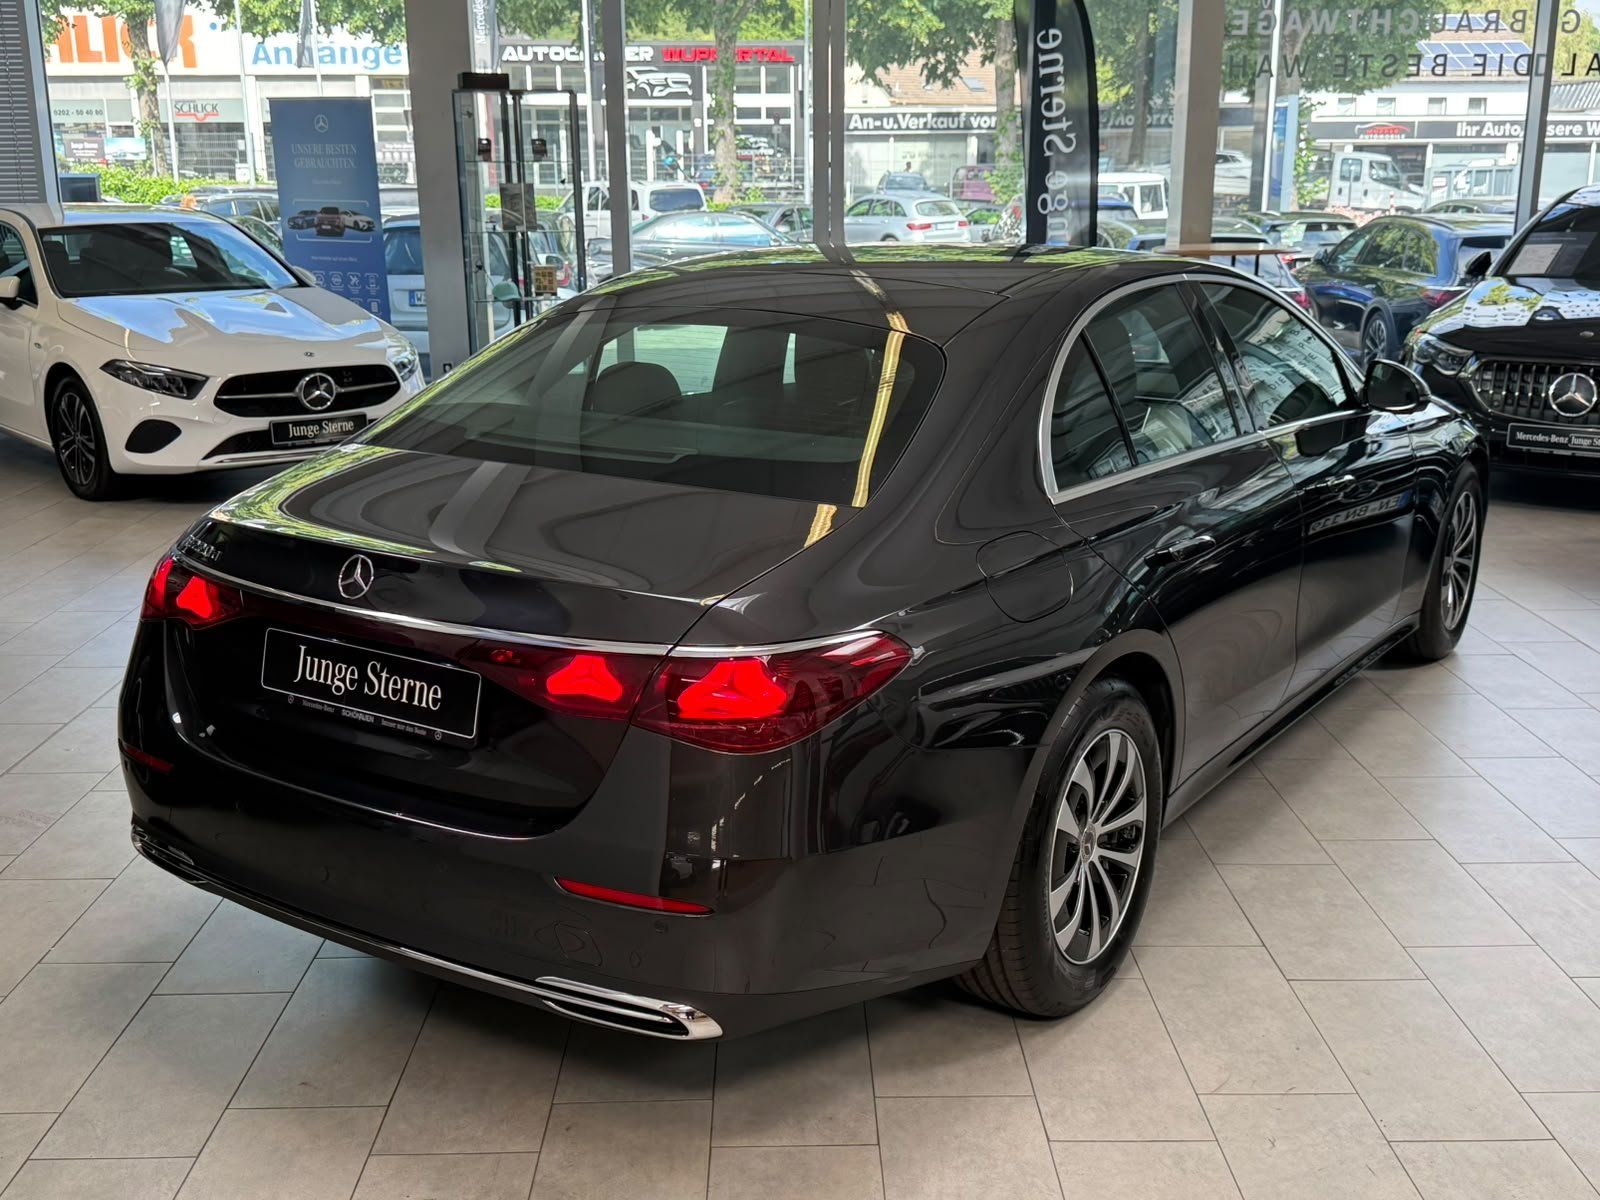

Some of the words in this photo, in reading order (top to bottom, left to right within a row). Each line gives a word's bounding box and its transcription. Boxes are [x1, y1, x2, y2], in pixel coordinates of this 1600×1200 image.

[501, 45, 654, 62] AUTOCER
[1456, 121, 1481, 137] Ihr
[288, 422, 320, 439] Junge
[322, 420, 355, 434] Sterne
[293, 644, 359, 696] Junge
[363, 660, 442, 711] Sterne
